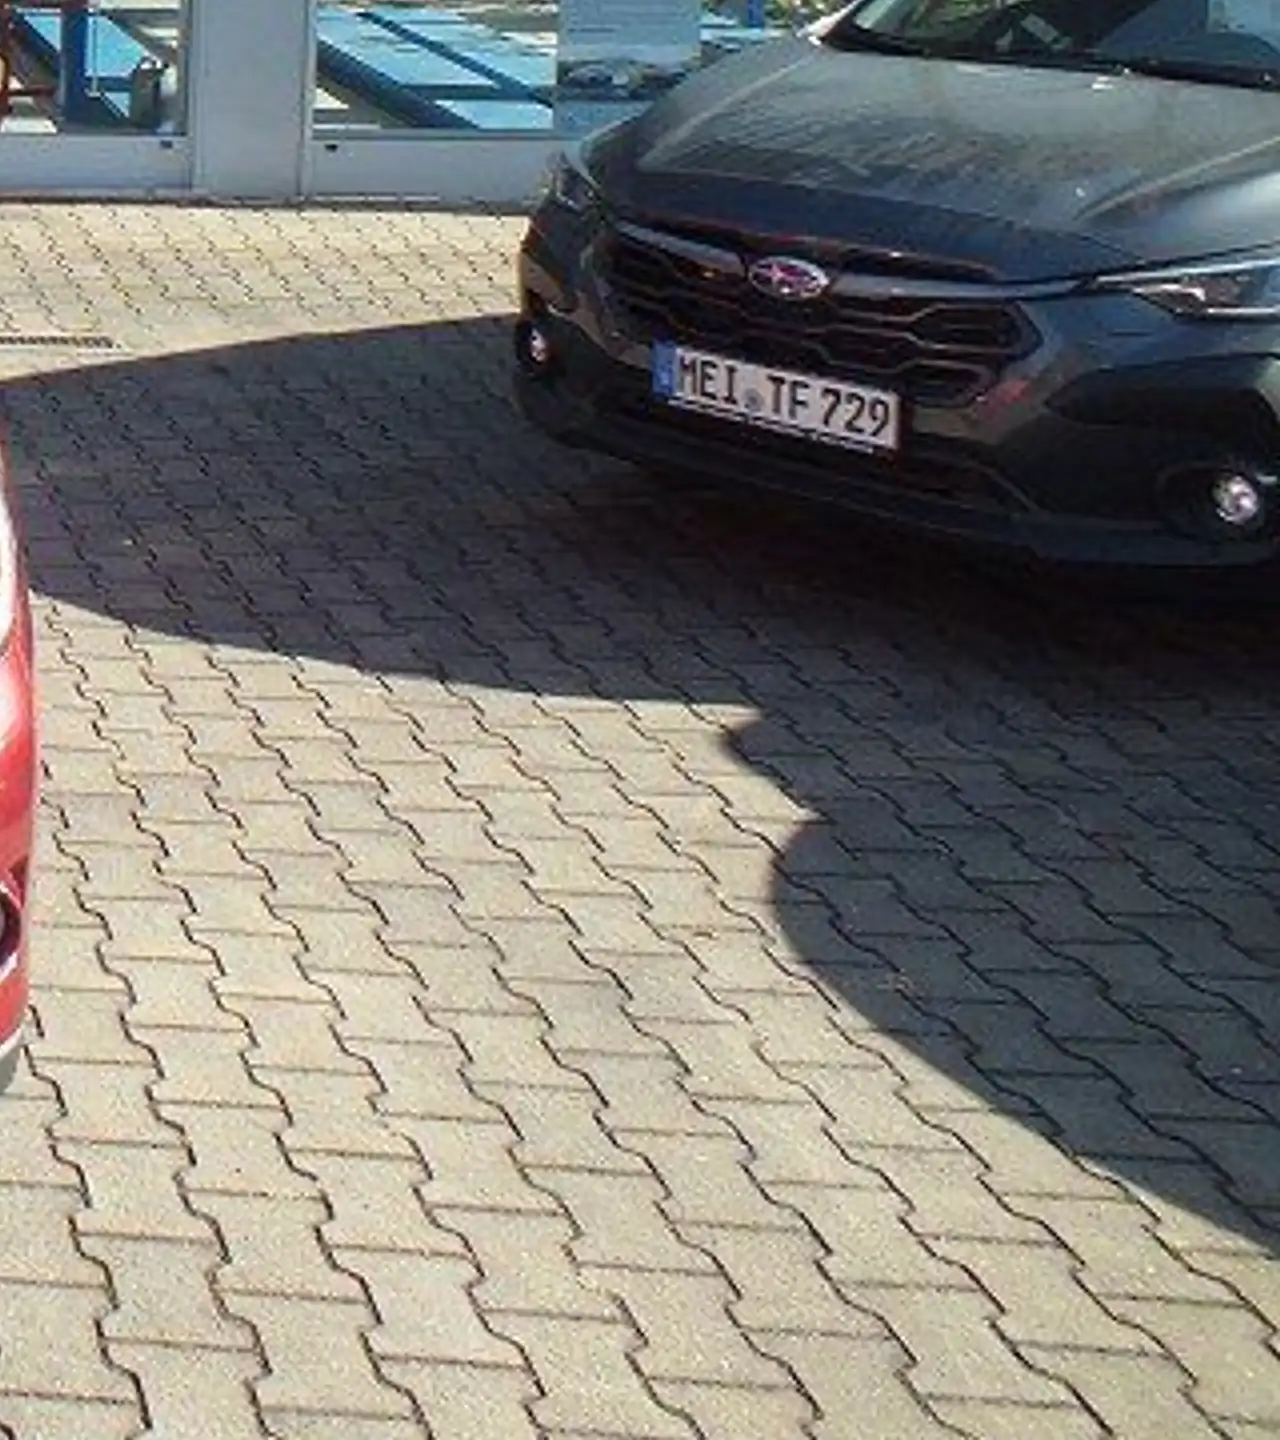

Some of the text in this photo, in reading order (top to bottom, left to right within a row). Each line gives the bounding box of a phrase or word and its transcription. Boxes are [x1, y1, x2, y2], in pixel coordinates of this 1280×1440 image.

[678, 355, 890, 438] MEI TF 729
